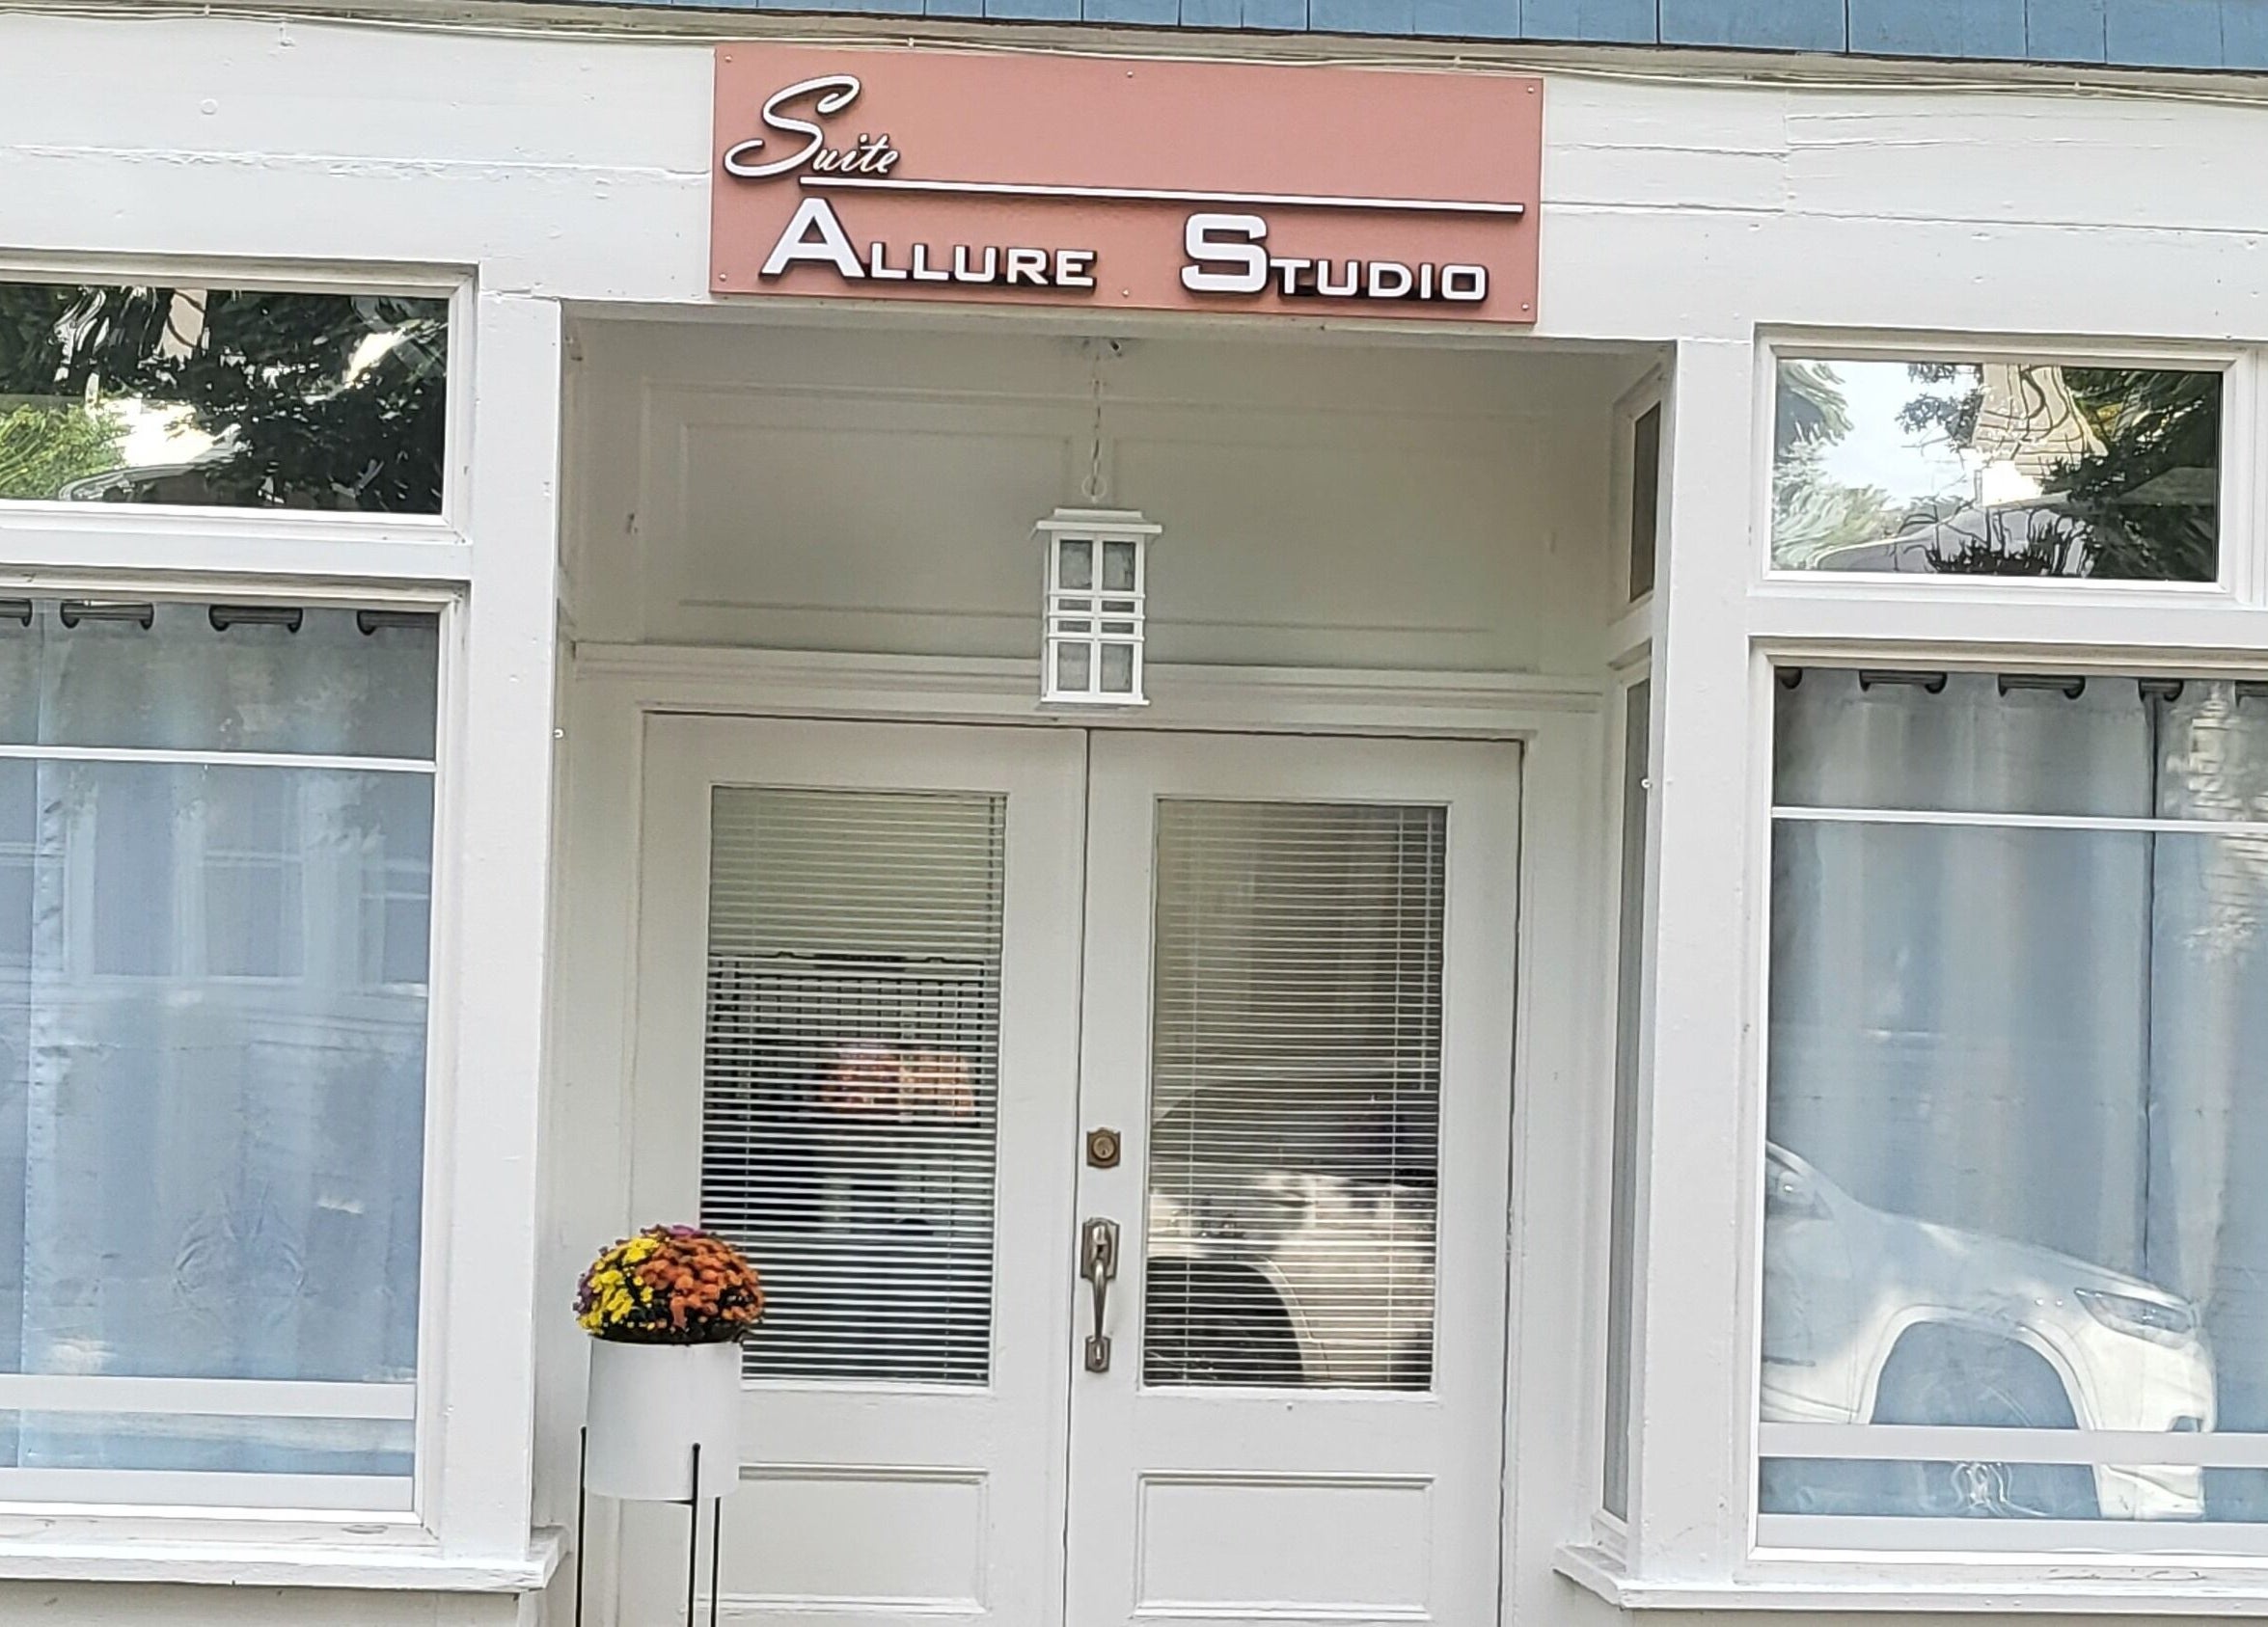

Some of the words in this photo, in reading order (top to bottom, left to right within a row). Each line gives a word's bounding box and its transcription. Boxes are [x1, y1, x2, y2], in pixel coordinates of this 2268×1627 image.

[724, 74, 899, 178] Suite
[761, 197, 1096, 289] ALLURE
[1181, 212, 1488, 301] STUDIO
